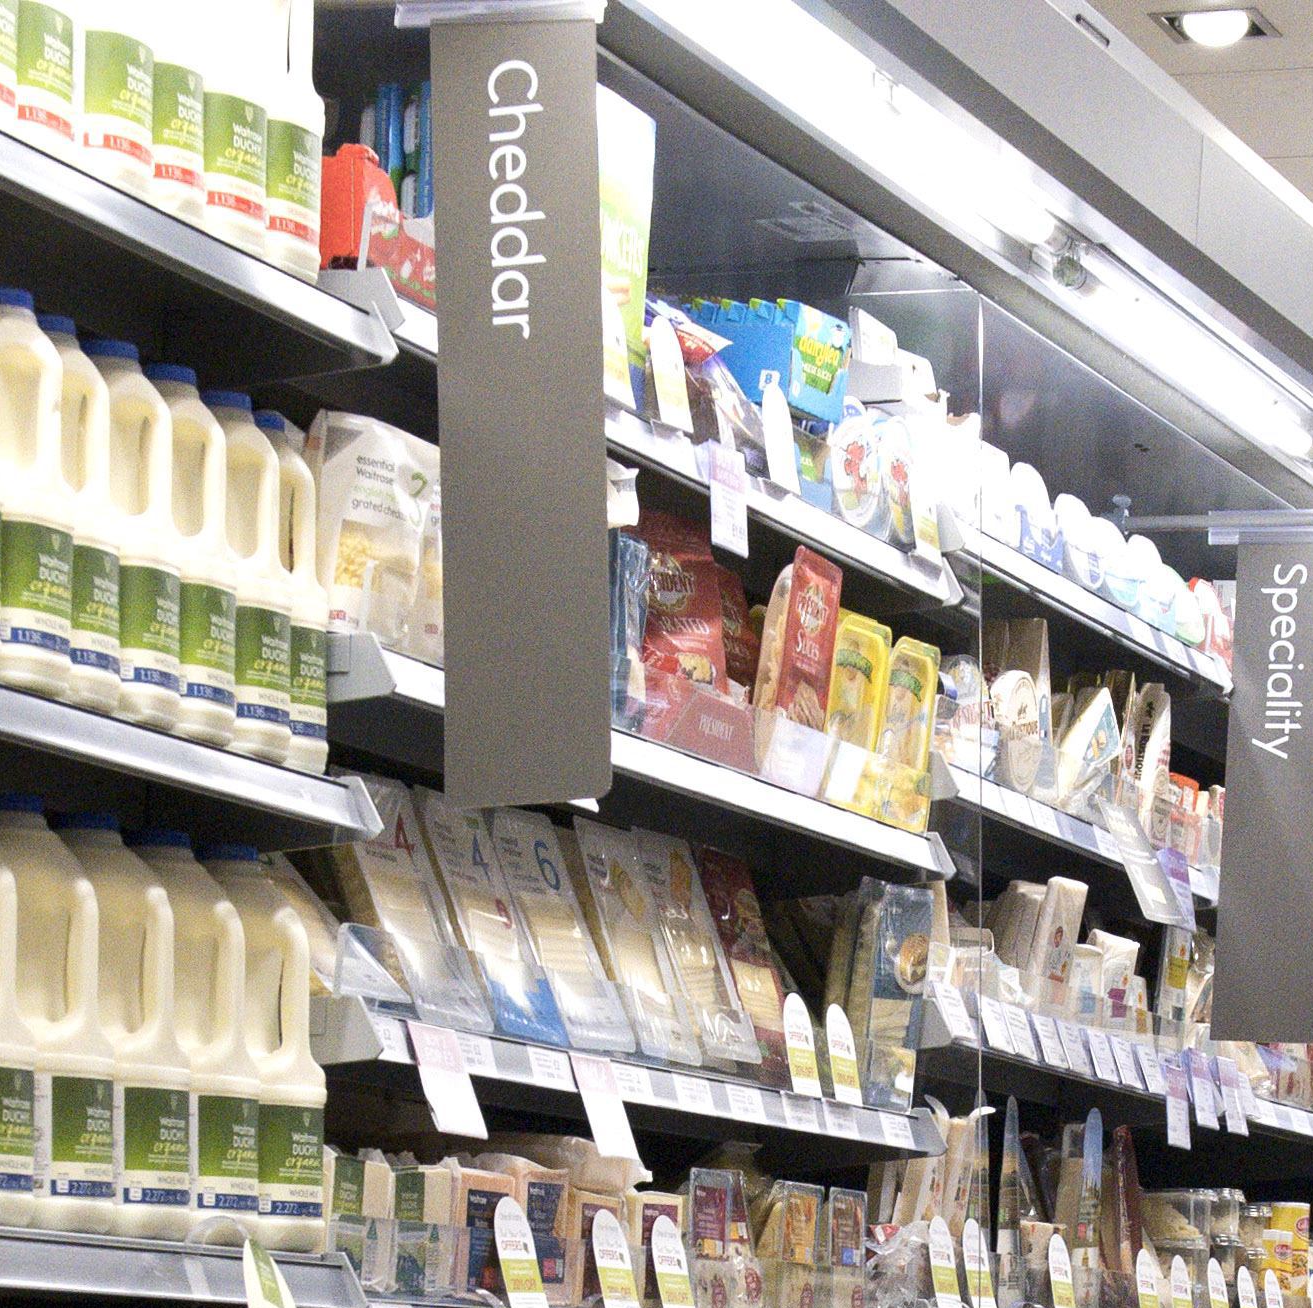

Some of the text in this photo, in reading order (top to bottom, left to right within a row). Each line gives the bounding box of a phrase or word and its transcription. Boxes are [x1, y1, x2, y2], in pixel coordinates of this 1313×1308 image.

[487, 58, 546, 341] Cheddar
[356, 454, 395, 473] essential
[356, 465, 394, 487] Waitrose
[1251, 563, 1308, 760] Speciality
[534, 840, 560, 891] 6
